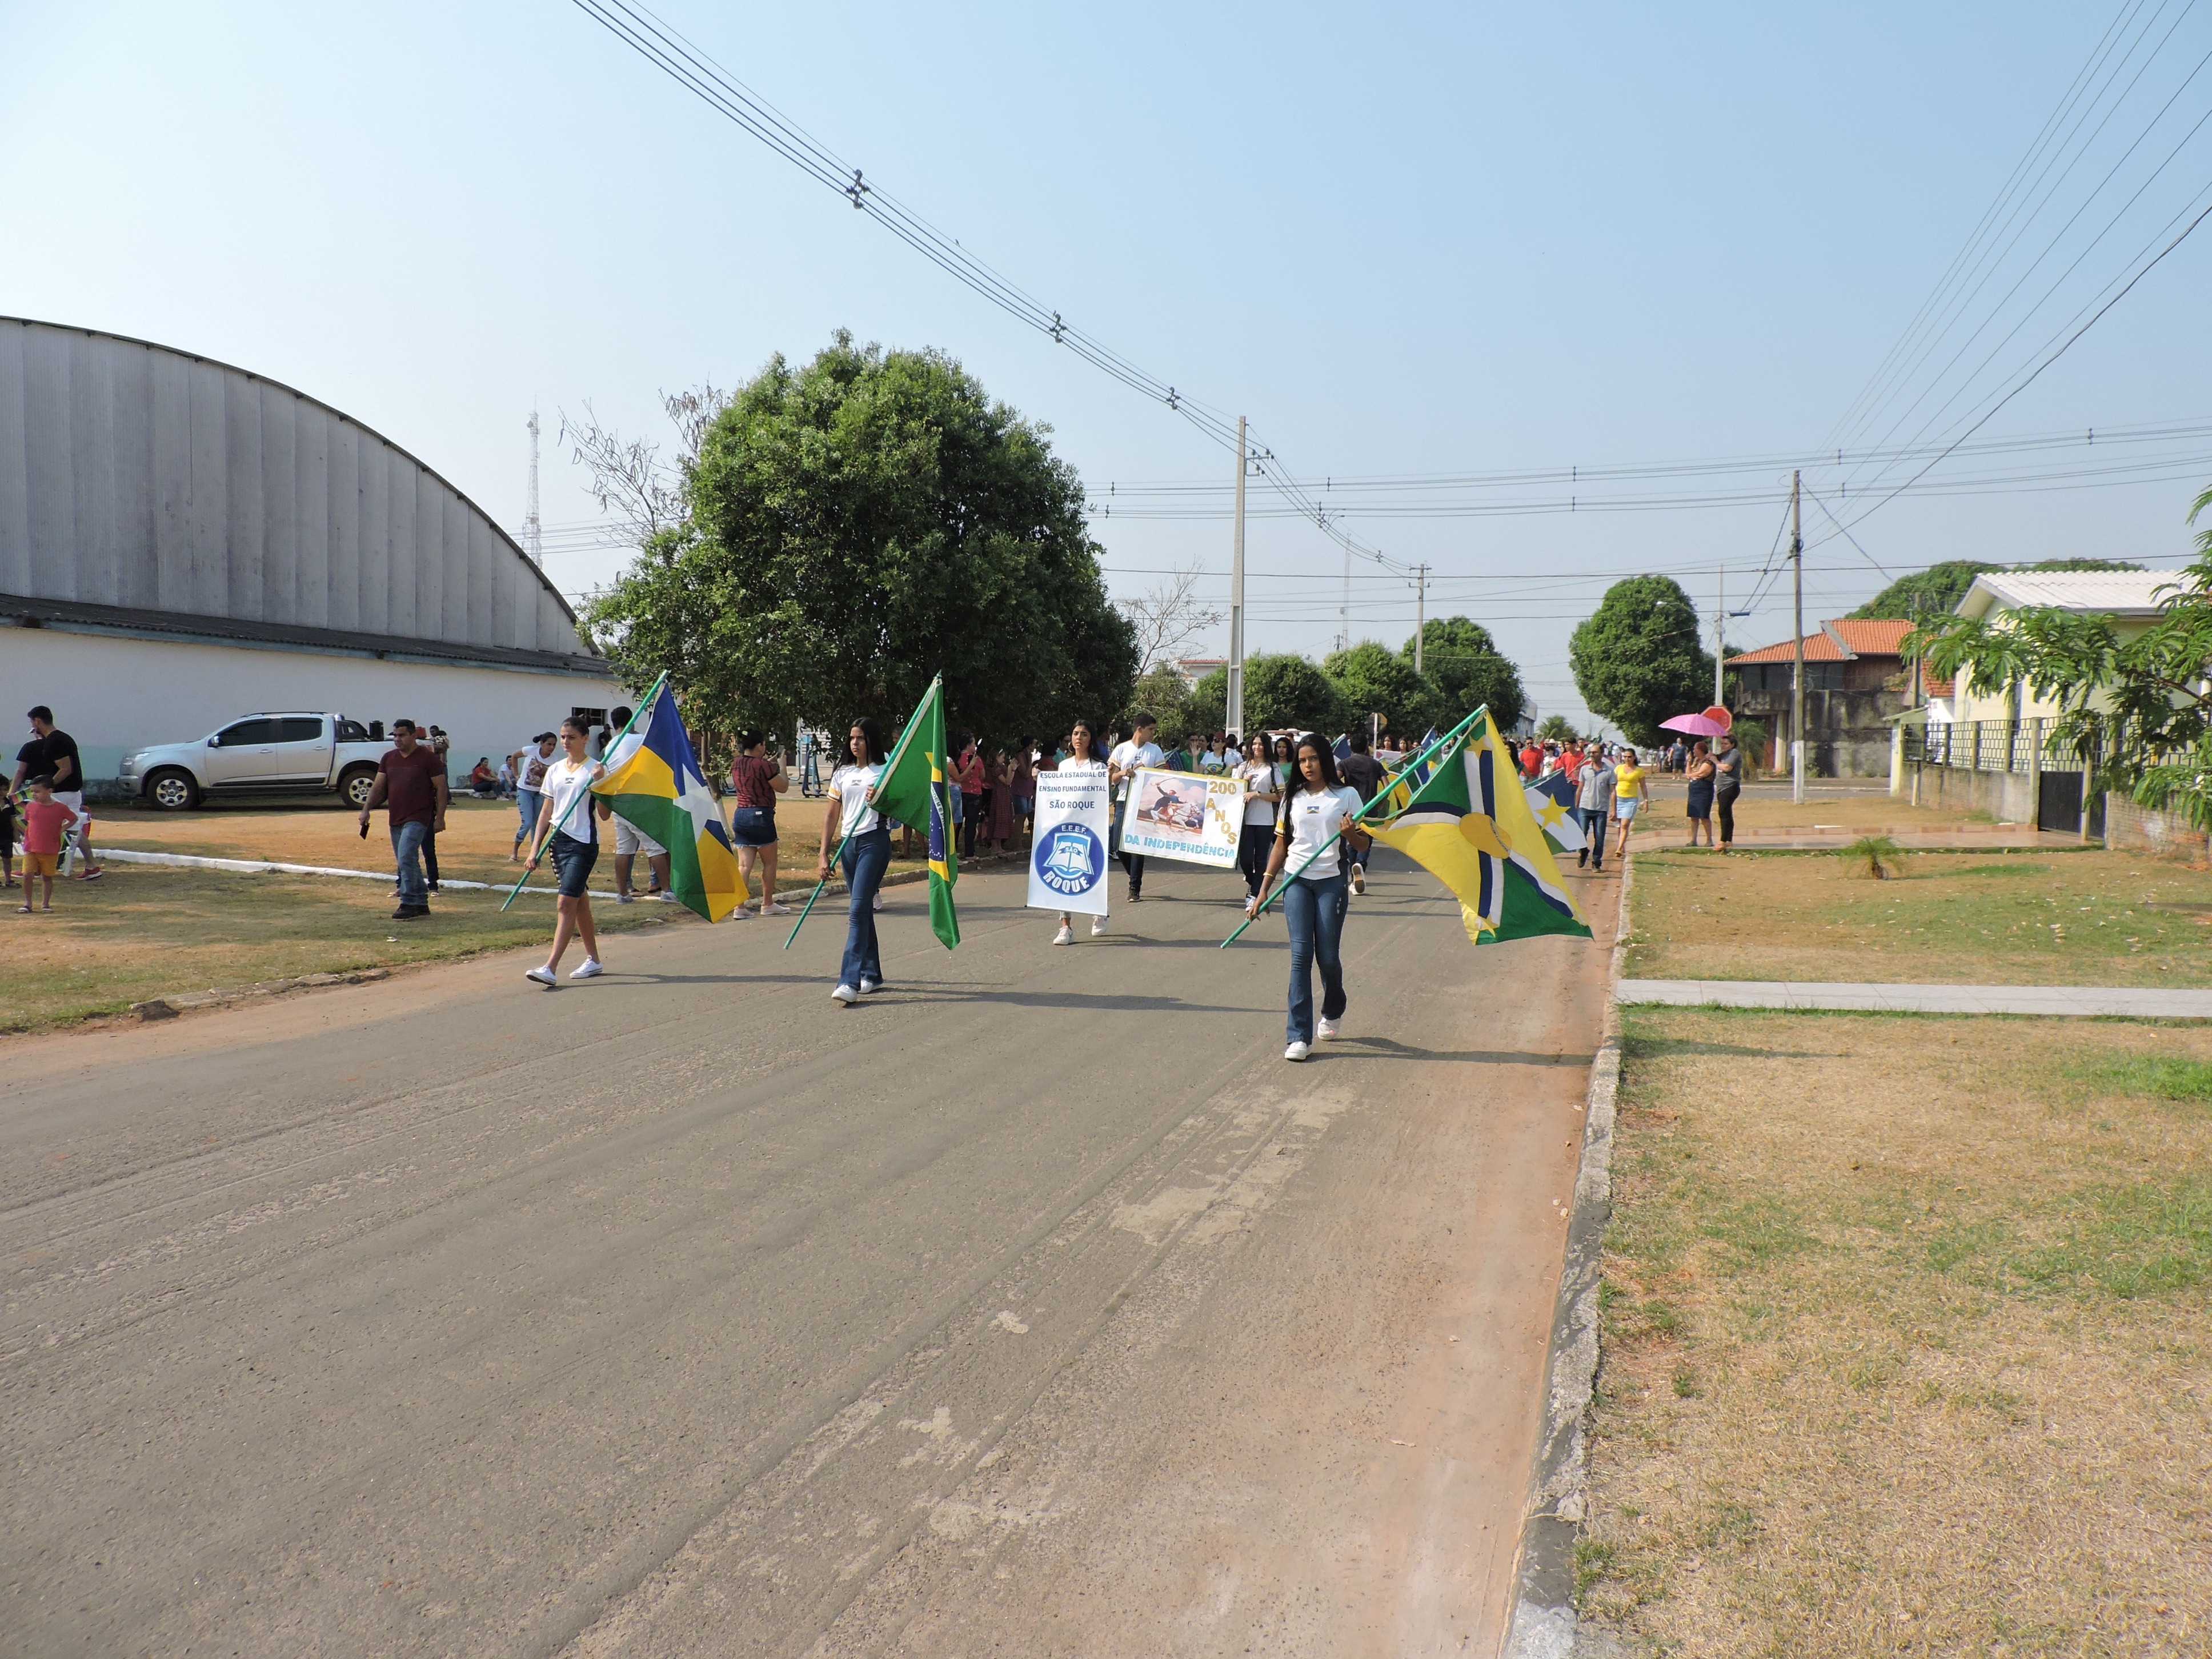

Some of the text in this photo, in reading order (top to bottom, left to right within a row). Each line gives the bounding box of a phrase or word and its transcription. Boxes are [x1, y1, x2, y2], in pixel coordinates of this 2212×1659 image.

[1209, 780, 1237, 795] 200
[1049, 800, 1095, 811] SÃO ROQUE
[1061, 825, 1087, 834] E.E.E.F.
[1124, 833, 1235, 858] DA INDEPENDÊNCIA
[1043, 871, 1090, 893] ROQUE
